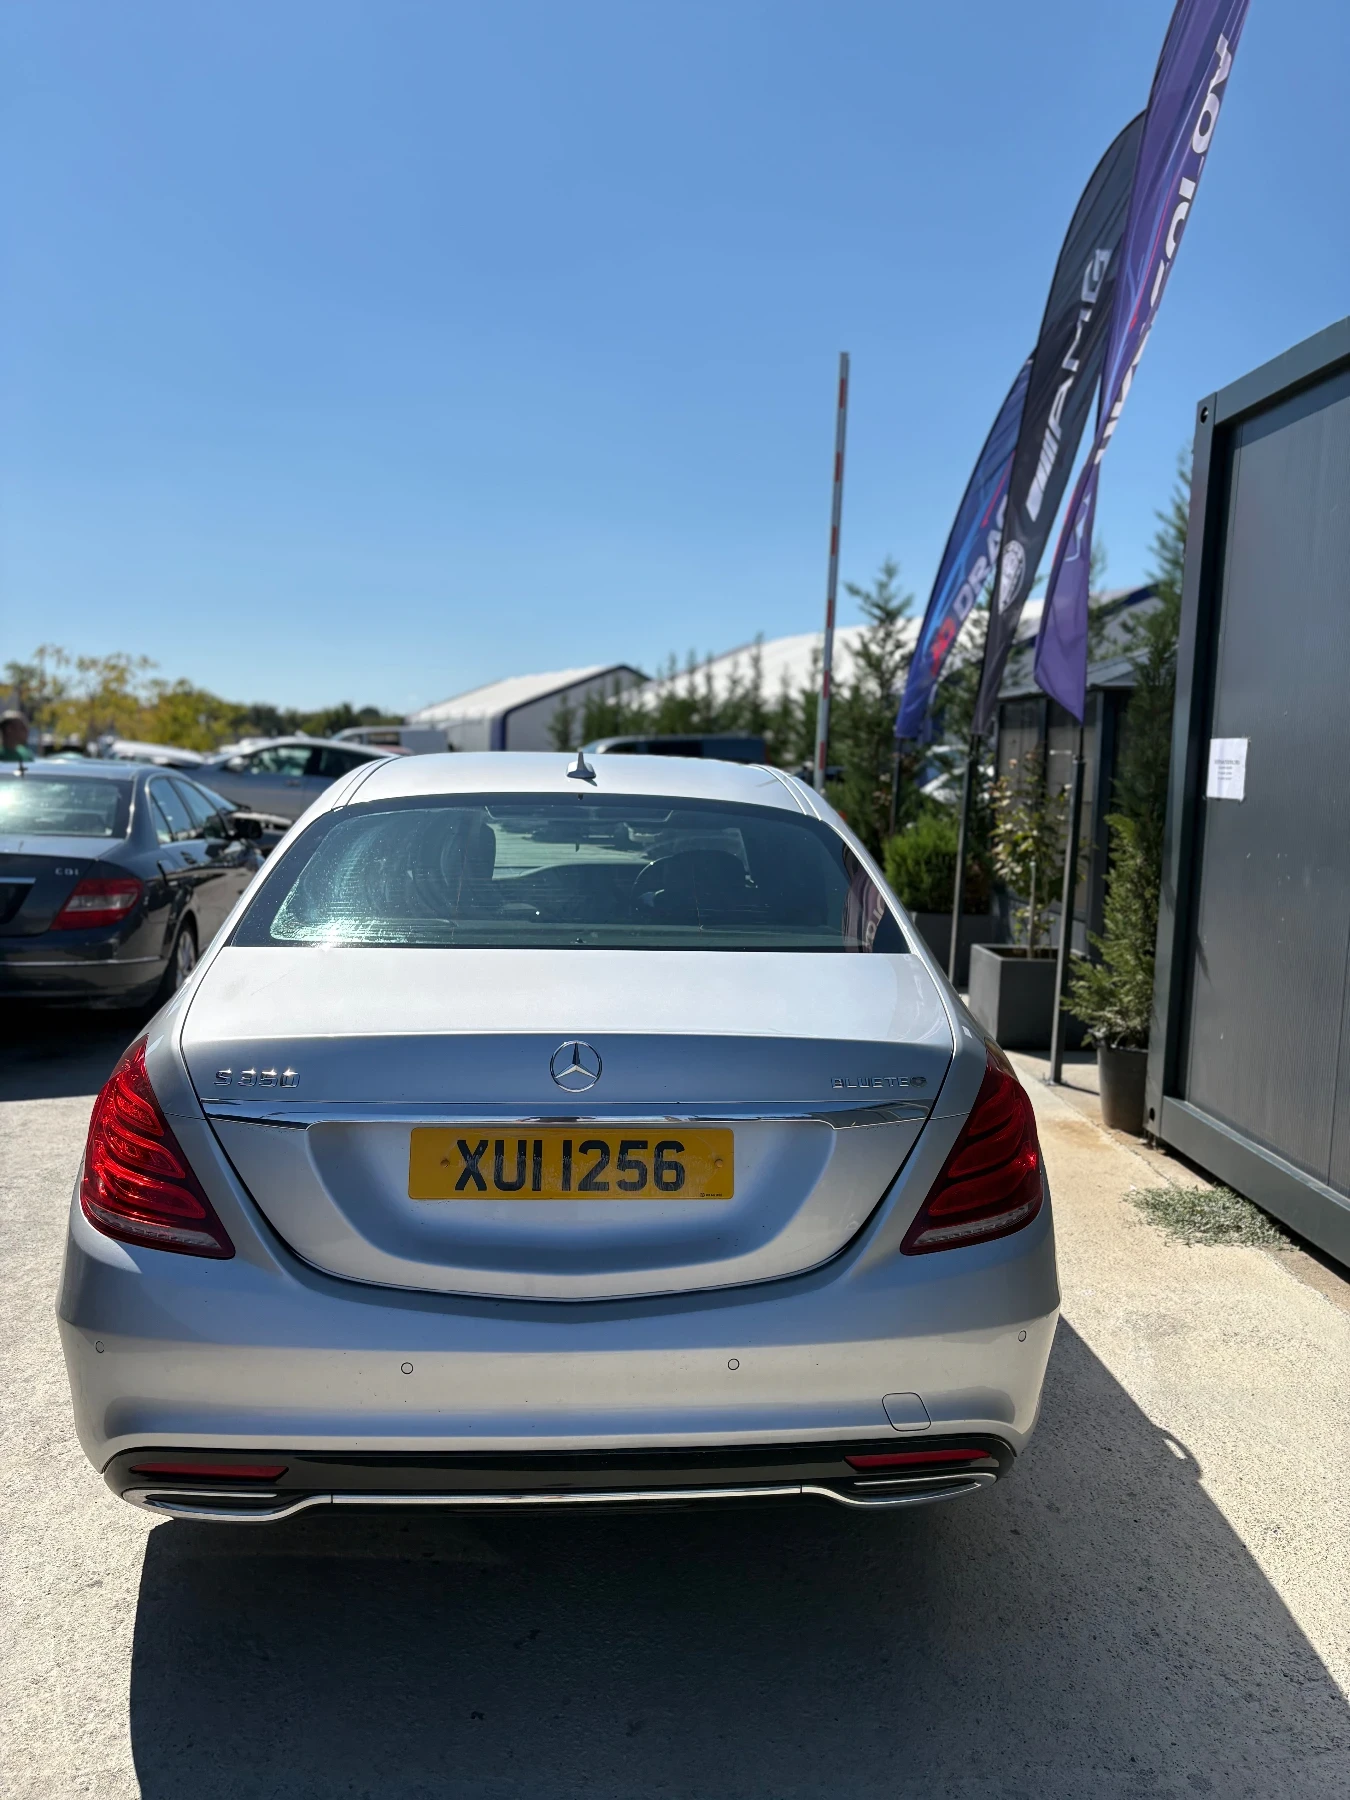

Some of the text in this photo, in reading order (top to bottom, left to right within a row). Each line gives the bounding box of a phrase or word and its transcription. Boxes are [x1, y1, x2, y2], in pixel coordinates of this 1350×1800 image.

[1048, 249, 1112, 441] AMG
[213, 1068, 300, 1088] S 350
[455, 1139, 685, 1191] XUI 1256
